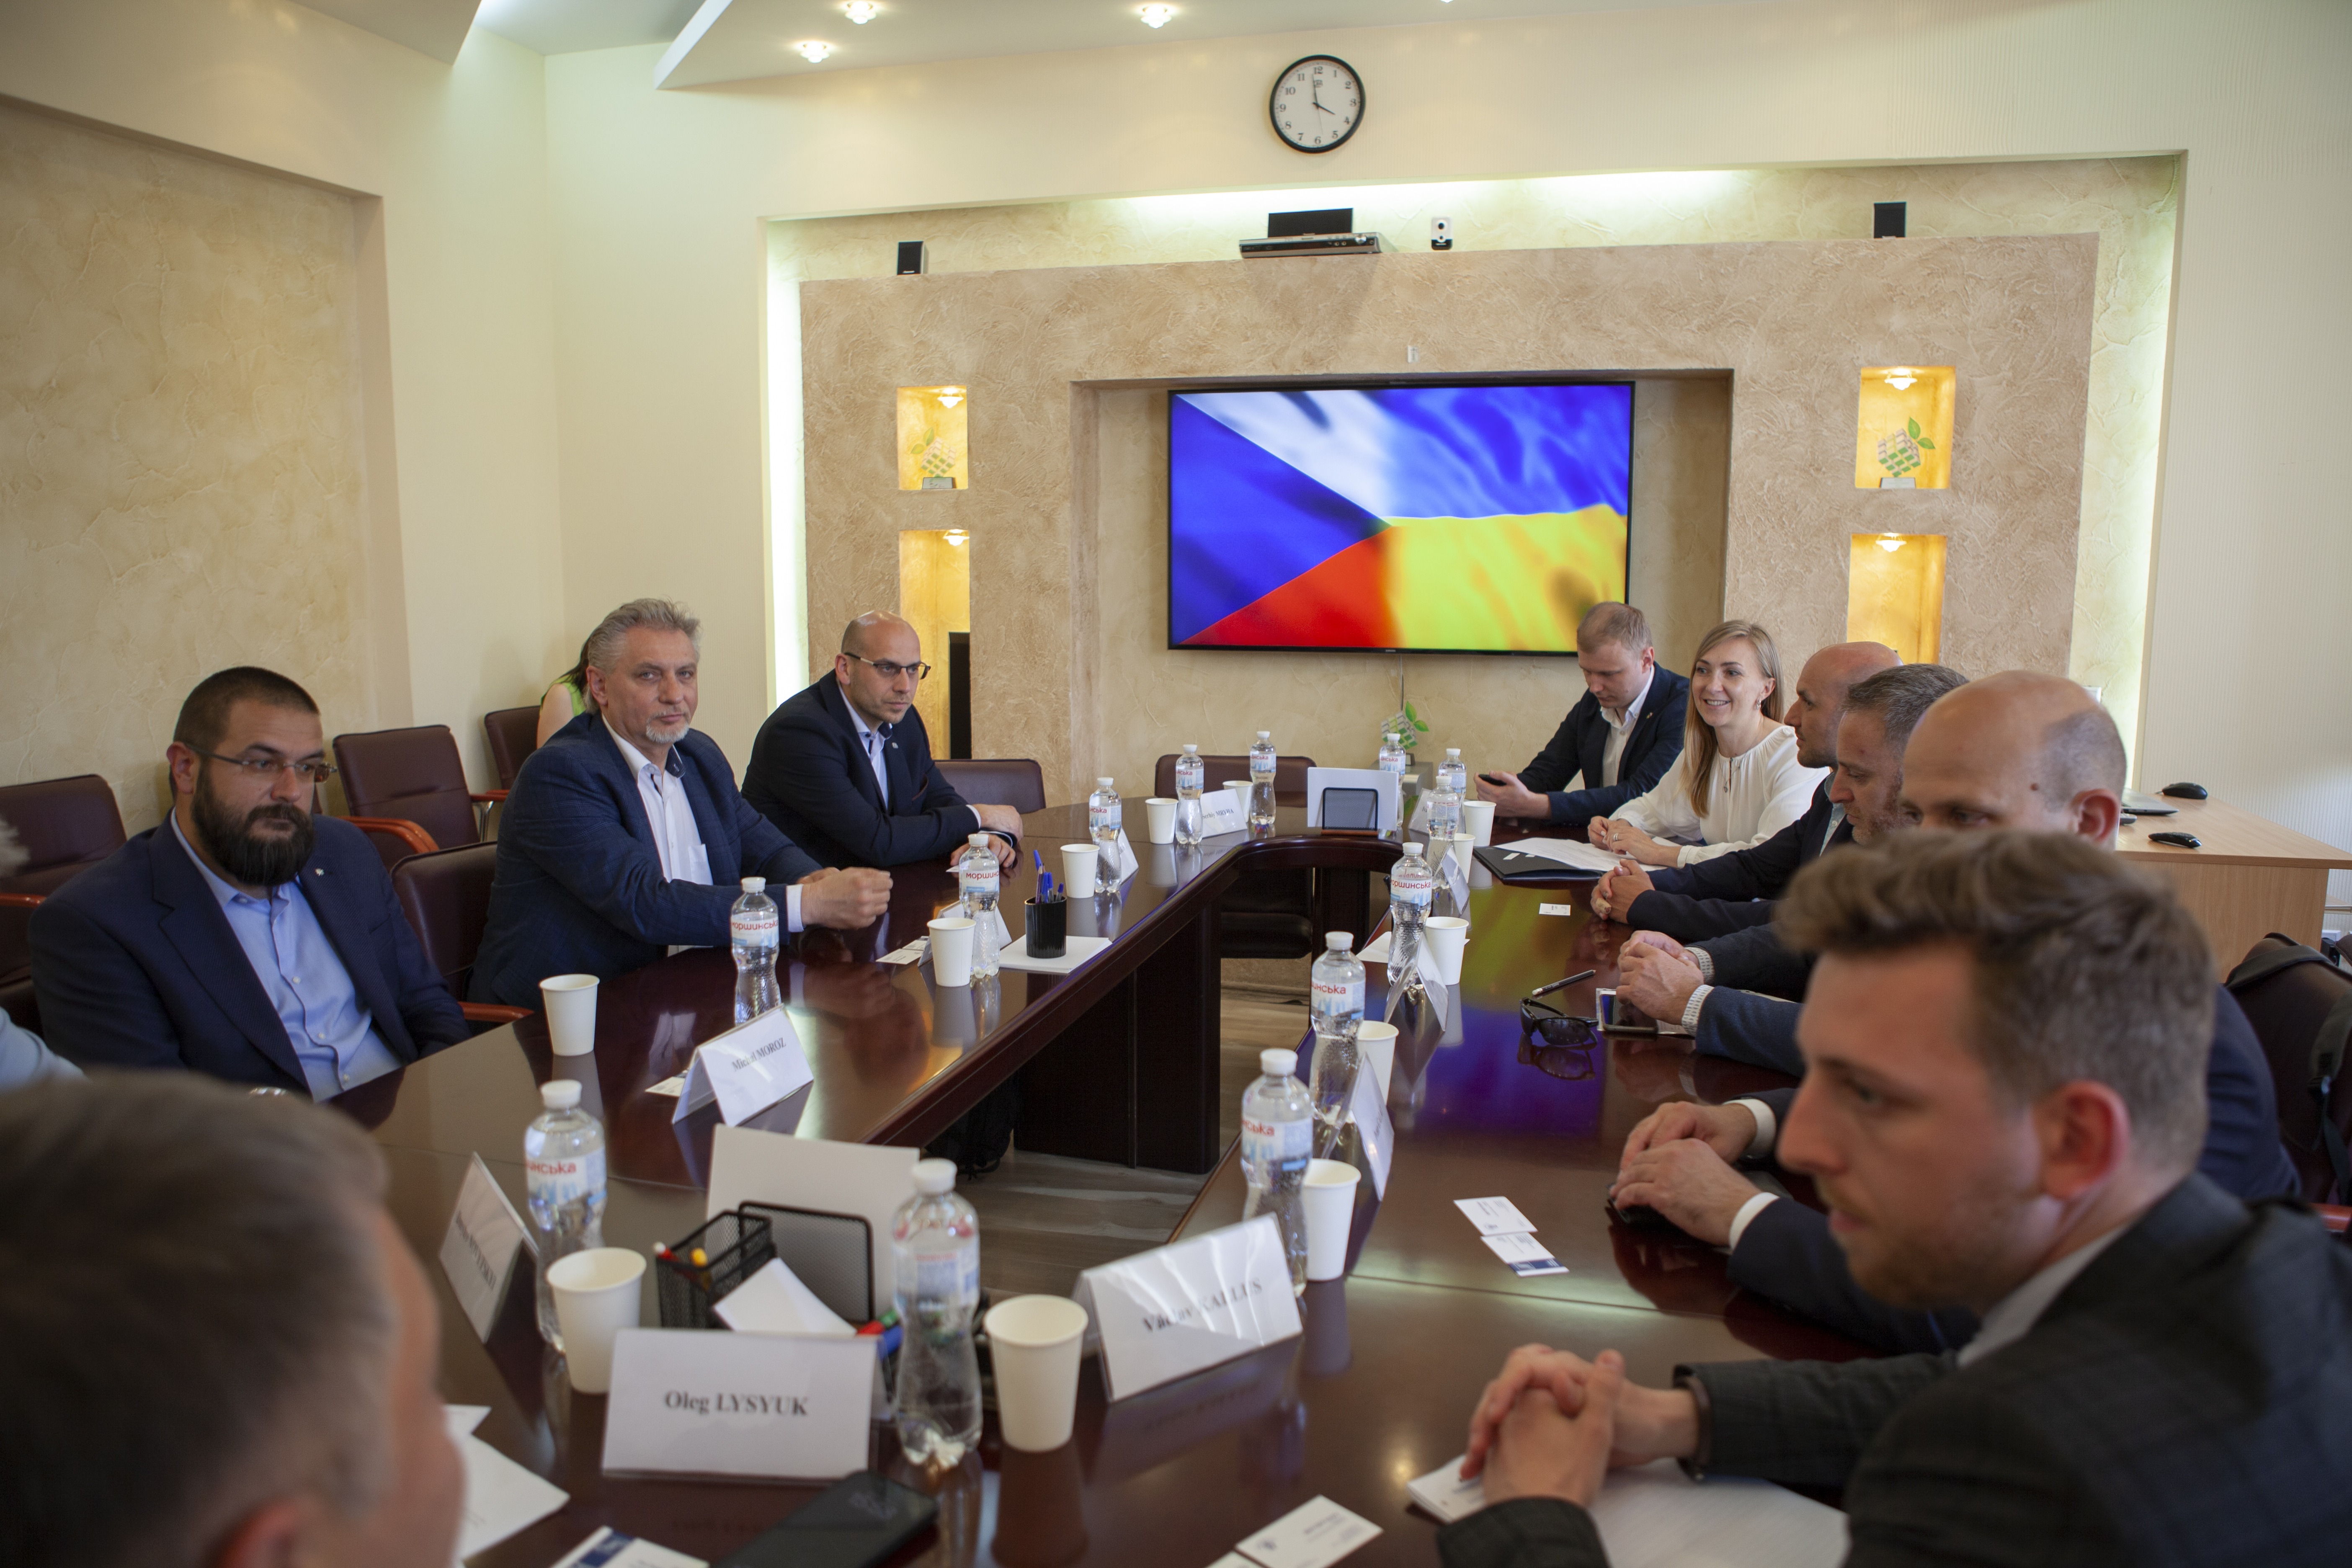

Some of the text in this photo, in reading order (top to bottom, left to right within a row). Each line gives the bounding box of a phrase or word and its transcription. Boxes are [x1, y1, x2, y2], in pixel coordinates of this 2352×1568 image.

[1314, 66, 1323, 75] 12
[1345, 81, 1351, 89] 2
[1350, 98, 1357, 107] 3
[1279, 104, 1286, 112] 9
[1344, 116, 1351, 124] 4
[1298, 132, 1304, 141] 7
[1332, 131, 1338, 139] 5
[757, 1037, 787, 1060] MOROZ
[665, 1390, 808, 1416] Oleg LYSYUK
